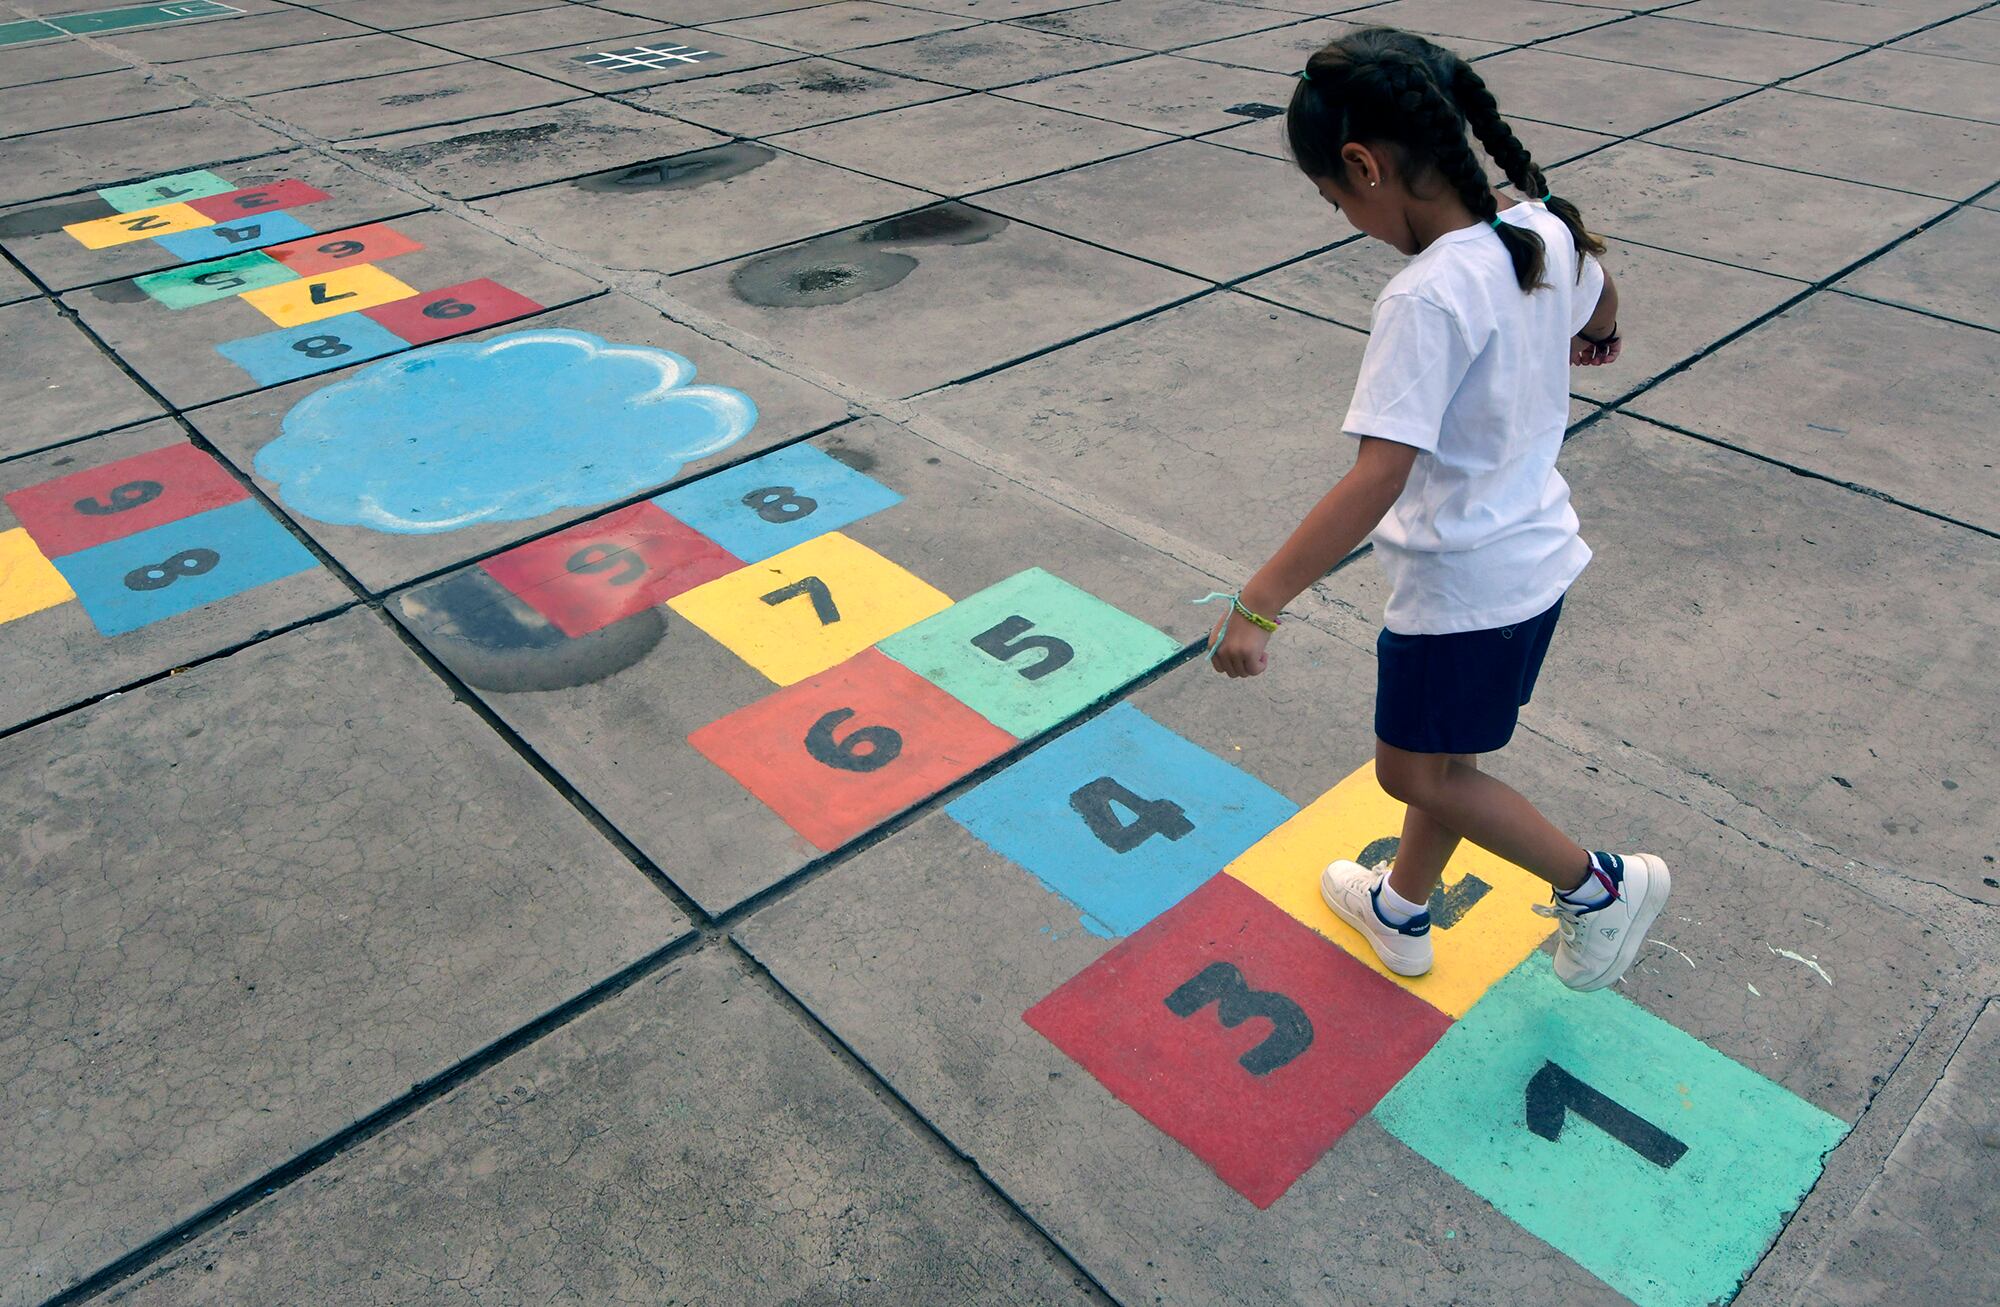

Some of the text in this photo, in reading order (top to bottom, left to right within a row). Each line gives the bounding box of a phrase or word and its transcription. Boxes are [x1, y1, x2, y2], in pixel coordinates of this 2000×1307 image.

[234, 193, 279, 209] 3
[120, 215, 171, 231] 2
[212, 224, 262, 244] 4
[193, 270, 247, 291] 5
[309, 283, 357, 305] 7
[291, 335, 352, 358] 8
[74, 480, 164, 515] 9
[741, 486, 819, 524] 8
[124, 548, 220, 591] 8
[566, 543, 648, 586] 9
[760, 576, 841, 626] 7
[970, 614, 1075, 681] 5
[804, 707, 903, 773] 6
[1068, 776, 1196, 855] 4
[1162, 961, 1314, 1077] 3
[1526, 1058, 1689, 1169] 1
